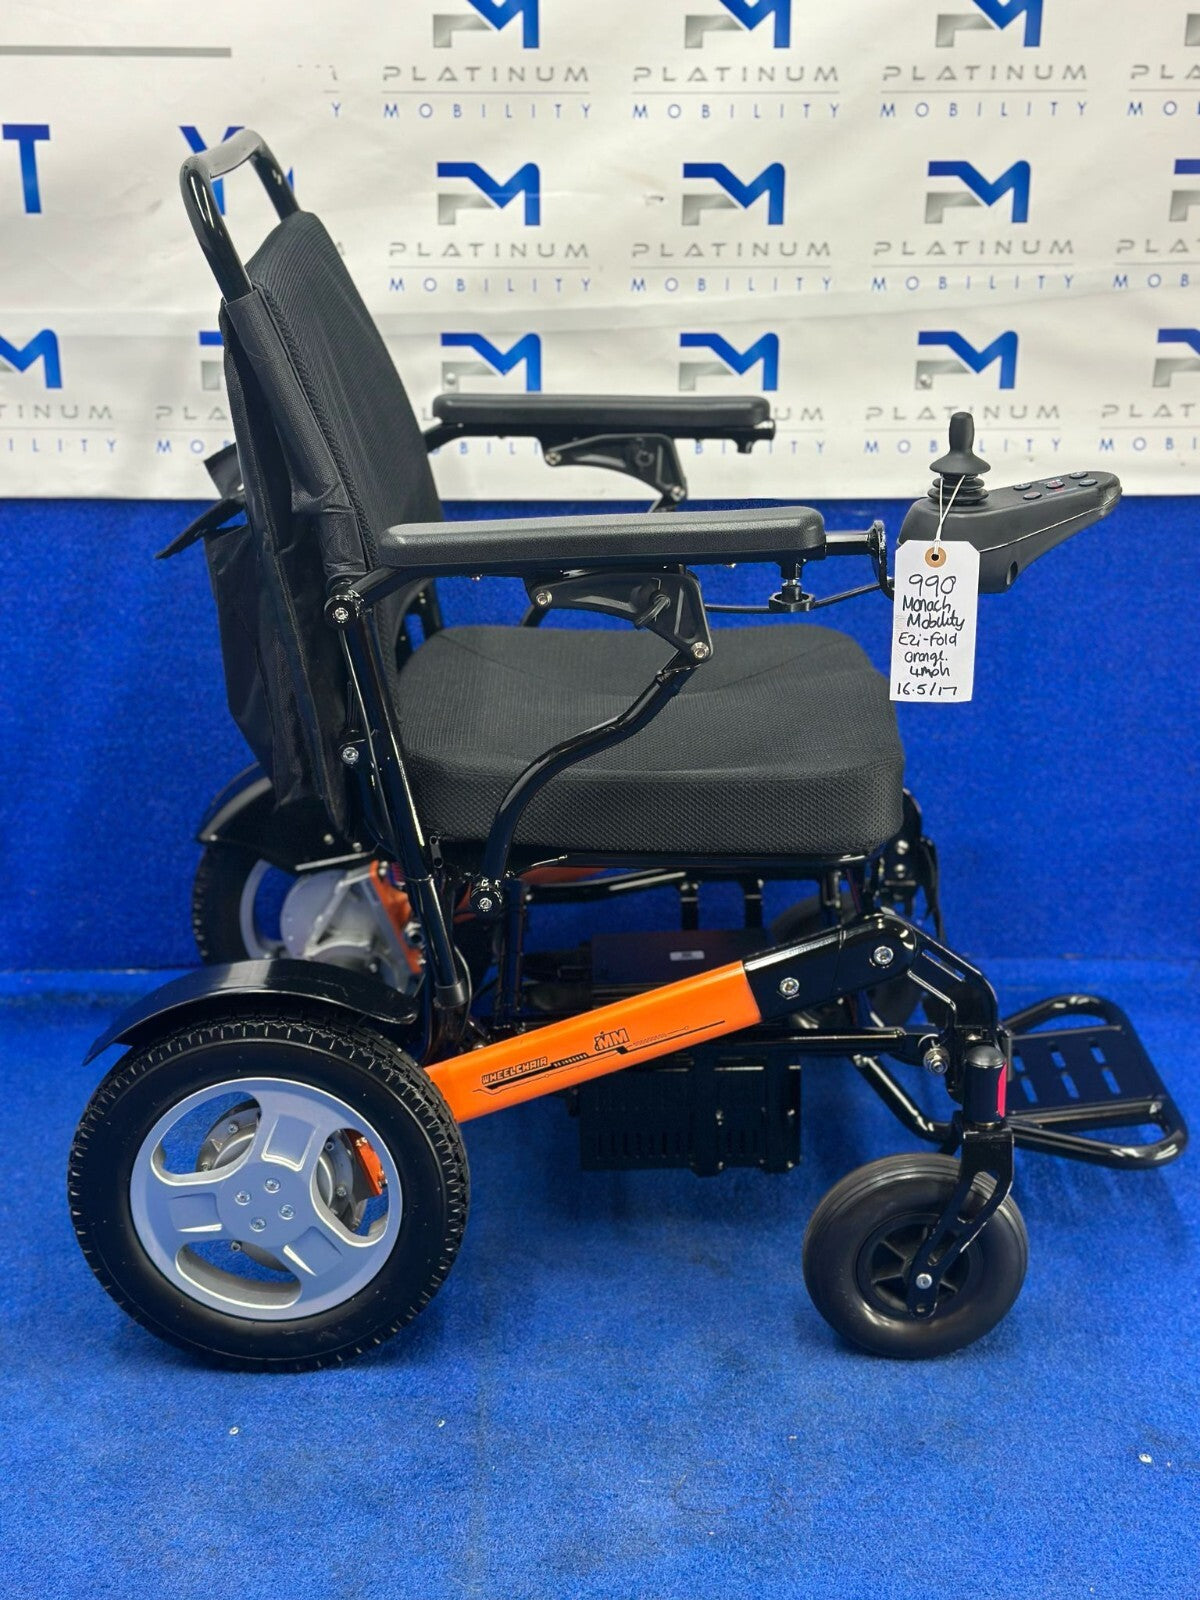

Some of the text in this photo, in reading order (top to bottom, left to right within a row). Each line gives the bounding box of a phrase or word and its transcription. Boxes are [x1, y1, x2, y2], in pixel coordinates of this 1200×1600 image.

[383, 66, 589, 82] PLATINUM
[633, 66, 839, 82] PLATINUM
[882, 64, 1087, 81] PLATINUM
[384, 103, 592, 119] MOBILITY
[632, 103, 839, 119] MOBILITY
[880, 101, 1087, 118] MOBILITY
[1127, 100, 1200, 117] MO
[389, 242, 589, 258] PLATINUM
[632, 241, 831, 258] PLATINUM
[873, 240, 1074, 256] PLATINUM
[1116, 239, 1200, 254] PLA
[389, 277, 592, 293] MOBILITY
[630, 276, 832, 292] MOBILITY
[871, 275, 1074, 291] MOBILITY
[864, 438, 1061, 454] MOBLITY
[908, 573, 957, 597] 990
[902, 594, 952, 614] Monach
[906, 609, 966, 632] Mobility
[481, 1056, 548, 1085] WHEELCHAIR
